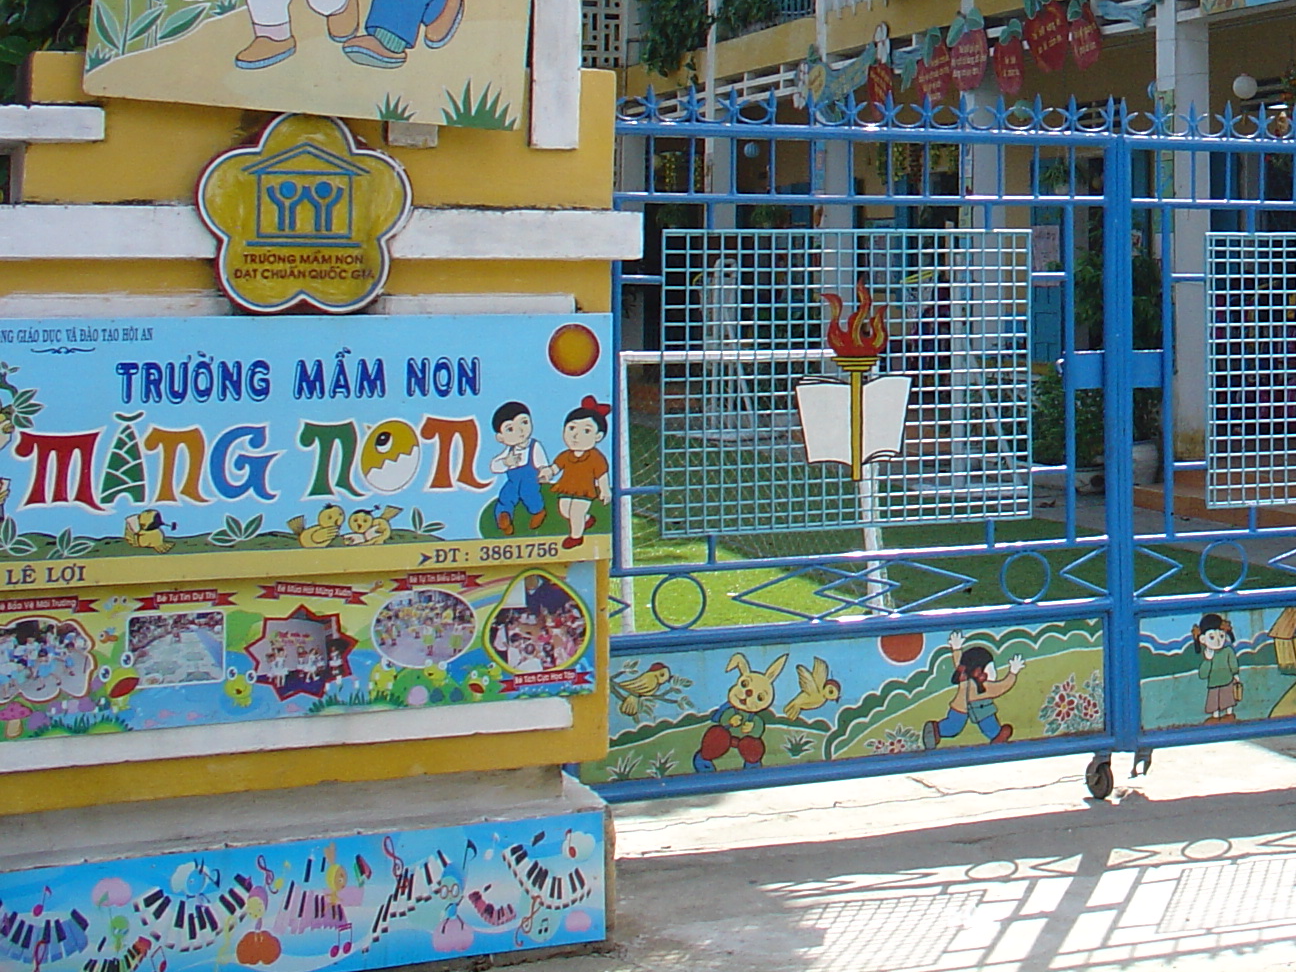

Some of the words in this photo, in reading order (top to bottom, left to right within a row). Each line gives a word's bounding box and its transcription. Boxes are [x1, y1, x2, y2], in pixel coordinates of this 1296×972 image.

[243, 249, 297, 265] TRƯỜNG
[300, 249, 332, 265] MẦM
[335, 254, 363, 265] NON
[234, 268, 258, 282] ĐẠT
[308, 265, 347, 280] QUỐC
[351, 269, 375, 280] GIA
[17, 327, 40, 343] GIÁO
[42, 329, 62, 344] DỤC
[80, 326, 99, 342] ĐÀO
[102, 328, 119, 344] TẠO
[122, 326, 139, 344] HỘI
[140, 328, 153, 341] AN
[115, 350, 271, 404] TRƯỜNG
[292, 347, 387, 400] MẦM
[405, 356, 481, 398] NON
[479, 542, 559, 562] 3861756
[6, 564, 37, 585] LÊ
[45, 563, 86, 585] LỢI
